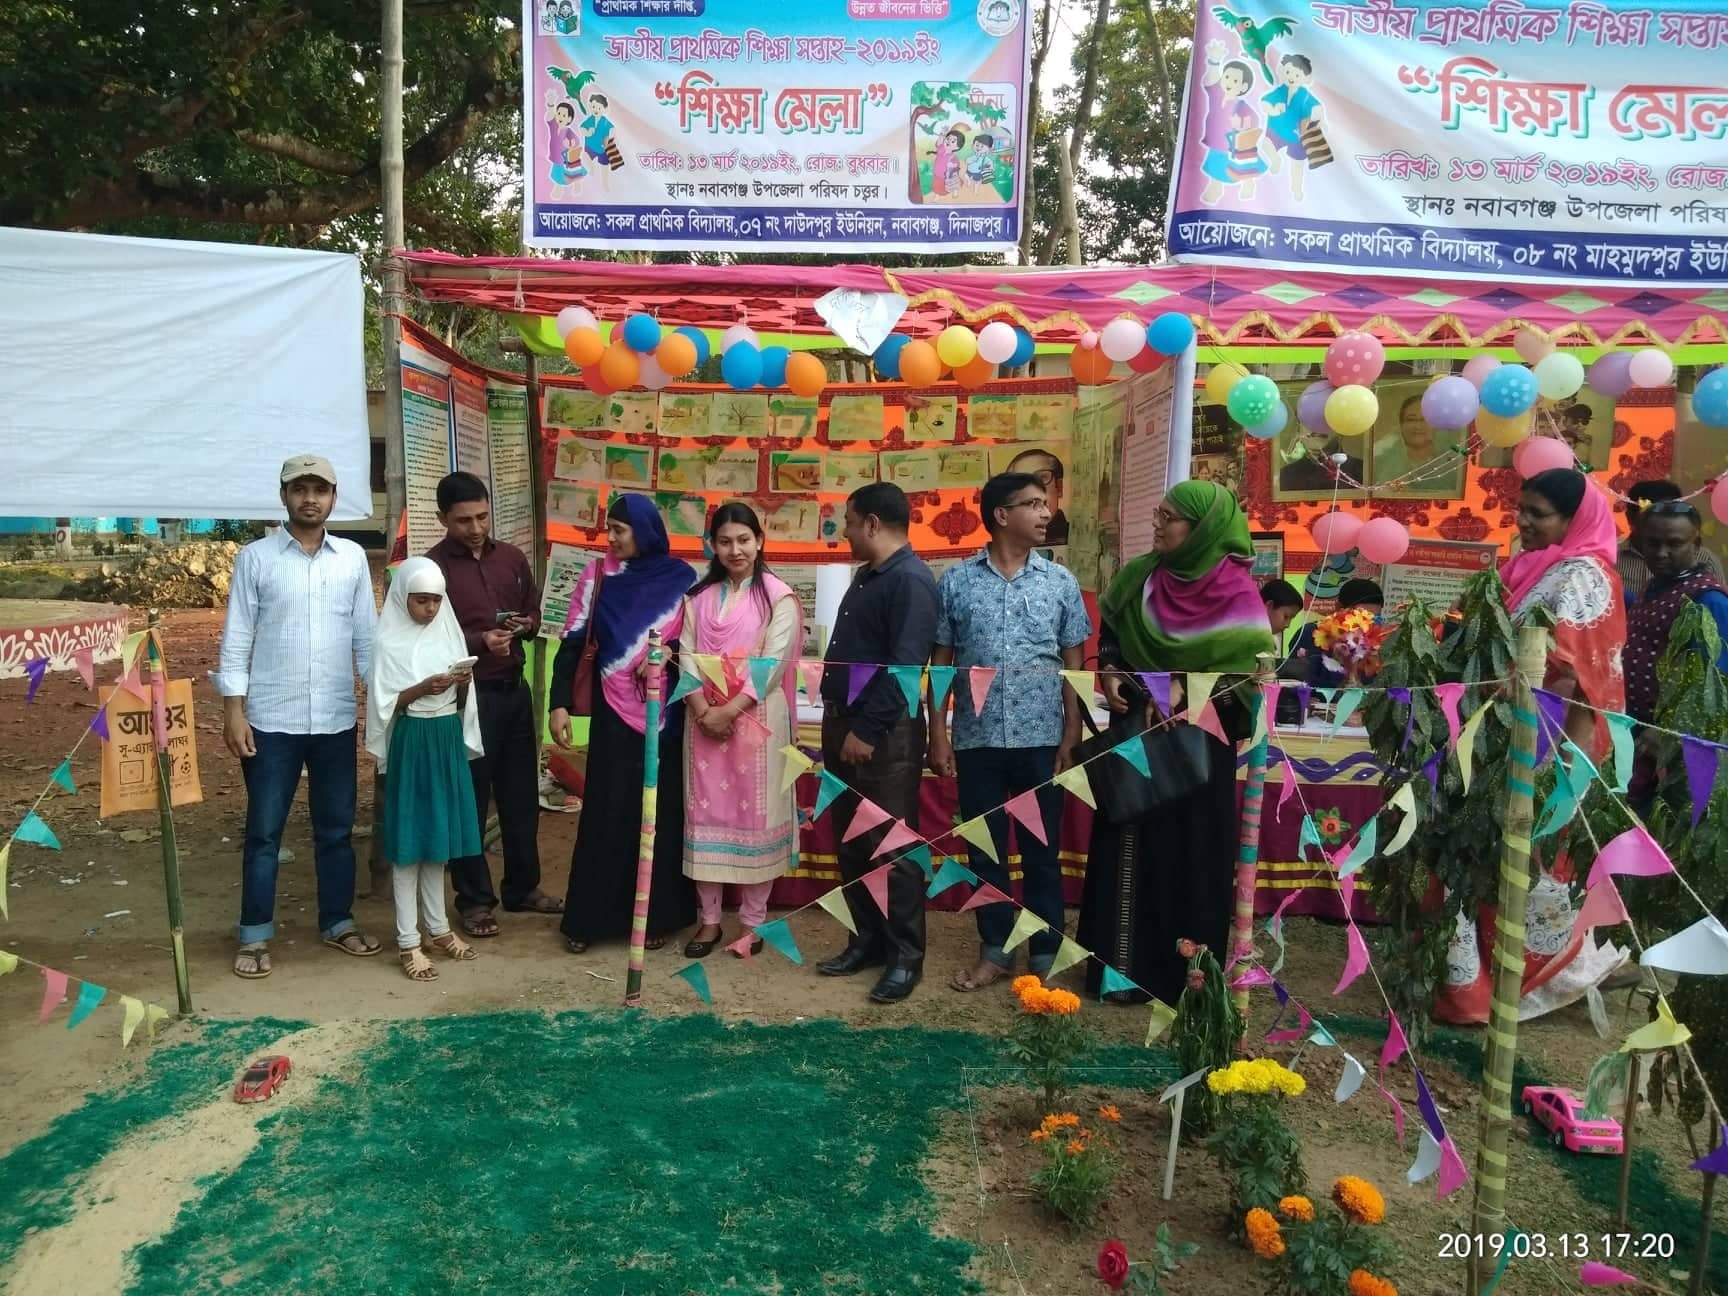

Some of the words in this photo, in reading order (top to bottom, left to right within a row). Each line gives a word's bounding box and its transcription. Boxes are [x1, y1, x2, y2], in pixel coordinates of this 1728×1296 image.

[1312, 0, 1418, 39] জাতীয়
[1420, 2, 1560, 46] প্রাথমিক
[1567, 0, 1650, 47] শিক্ষা
[604, 27, 664, 62] জাতীয়
[668, 28, 741, 63] প্রাথমিক
[745, 28, 792, 63] শিক্ষা
[688, 155, 708, 171] ১৩
[712, 149, 738, 171] মার্চ
[1449, 158, 1487, 182] ১৩
[1491, 153, 1545, 184] মার্চ
[700, 182, 748, 198] নবাবগঞ্জ
[753, 180, 804, 200] উপজেলা
[809, 180, 848, 200] পরিষদ
[605, 213, 635, 231] সকল
[639, 208, 685, 233] প্রাথমিক
[766, 215, 780, 234] নং
[784, 212, 832, 239] দাউদপুর
[836, 210, 887, 239] ইউনিয়ন,
[891, 216, 943, 238] নবাবগঞ্জ,
[1464, 197, 1556, 219] নবাবগঞ্জ
[1565, 195, 1662, 223] উপজেলা
[1283, 228, 1334, 253] সকল
[1338, 227, 1415, 258] প্রাথমিক
[1421, 229, 1503, 269] বিদ্যালয়,
[1513, 243, 1546, 267] ০৮
[1552, 243, 1578, 270] নং
[1585, 242, 1684, 278] মাহমুদপুর
